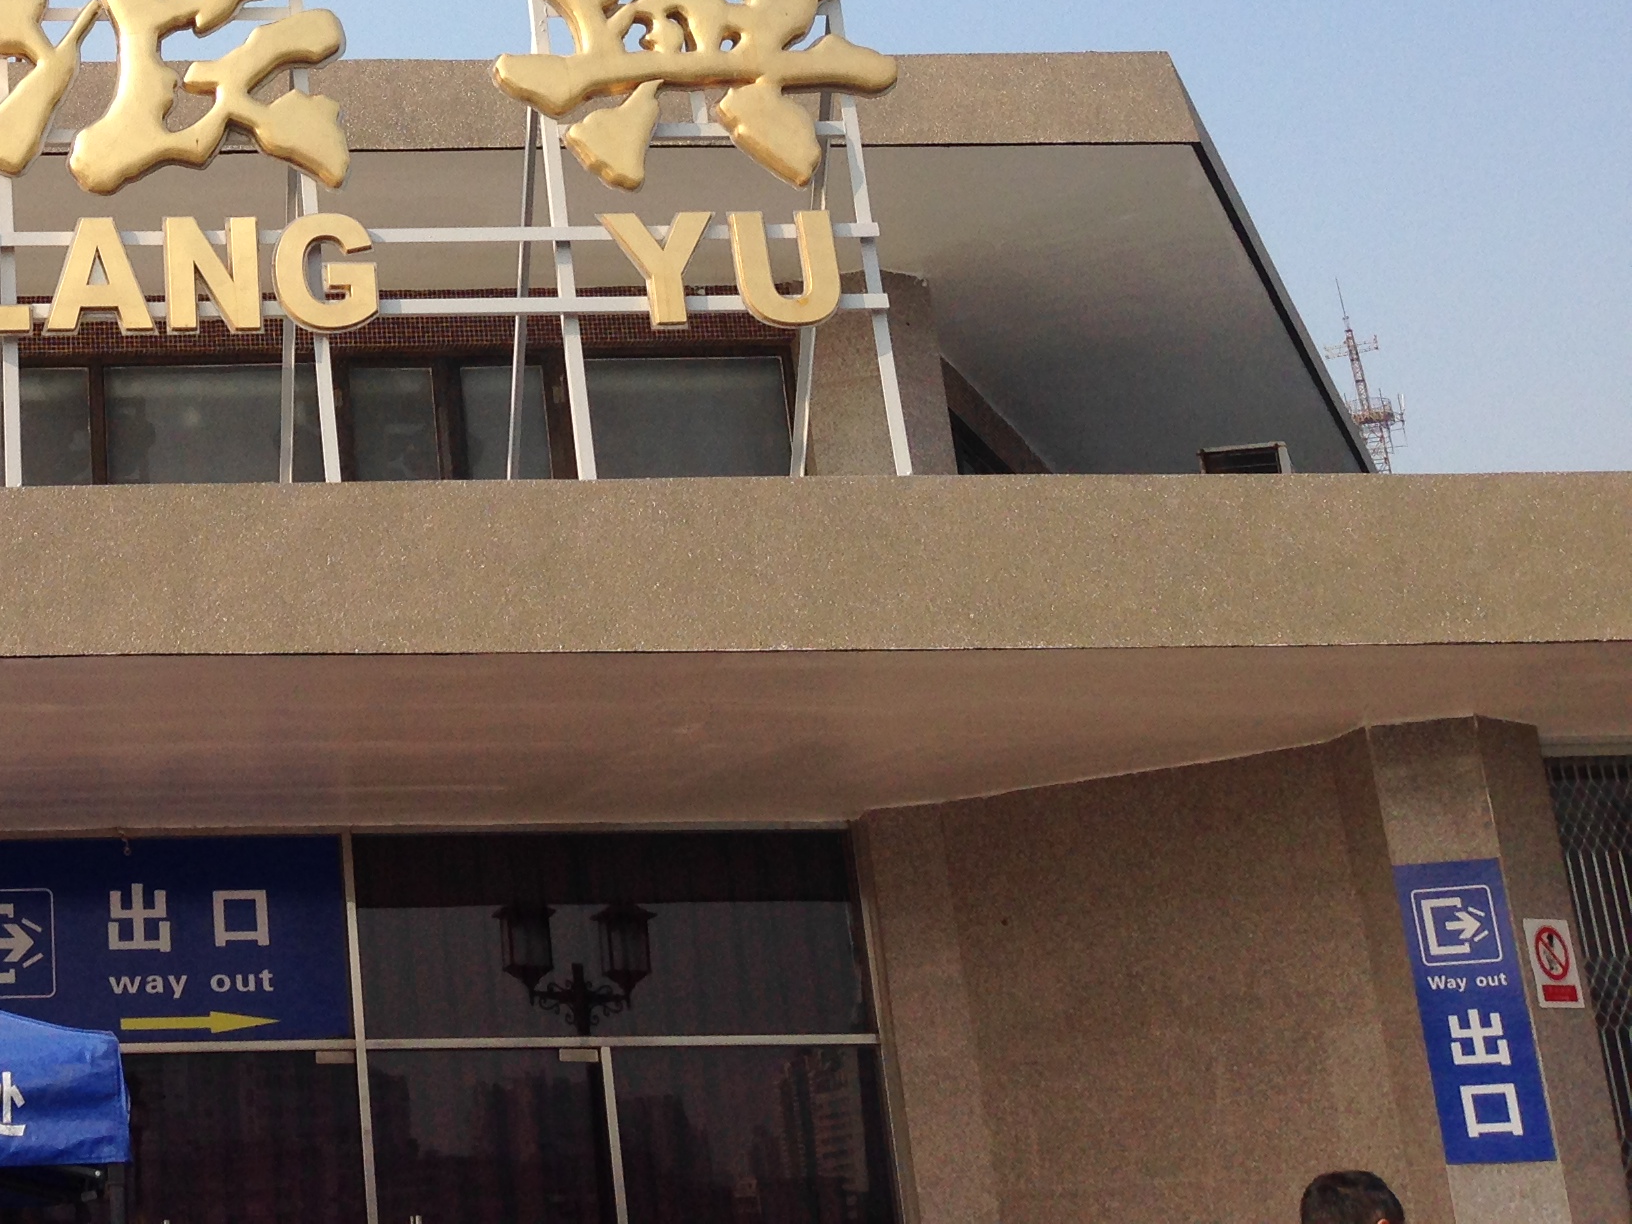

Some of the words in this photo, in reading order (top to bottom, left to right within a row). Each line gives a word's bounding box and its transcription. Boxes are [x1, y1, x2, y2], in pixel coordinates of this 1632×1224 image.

[599, 210, 842, 331] YU
[107, 882, 271, 953] 出口
[108, 974, 188, 999] way
[210, 969, 275, 993] out
[1427, 975, 1467, 992] Way
[1476, 973, 1508, 987] out
[1448, 1008, 1524, 1139] 出口
